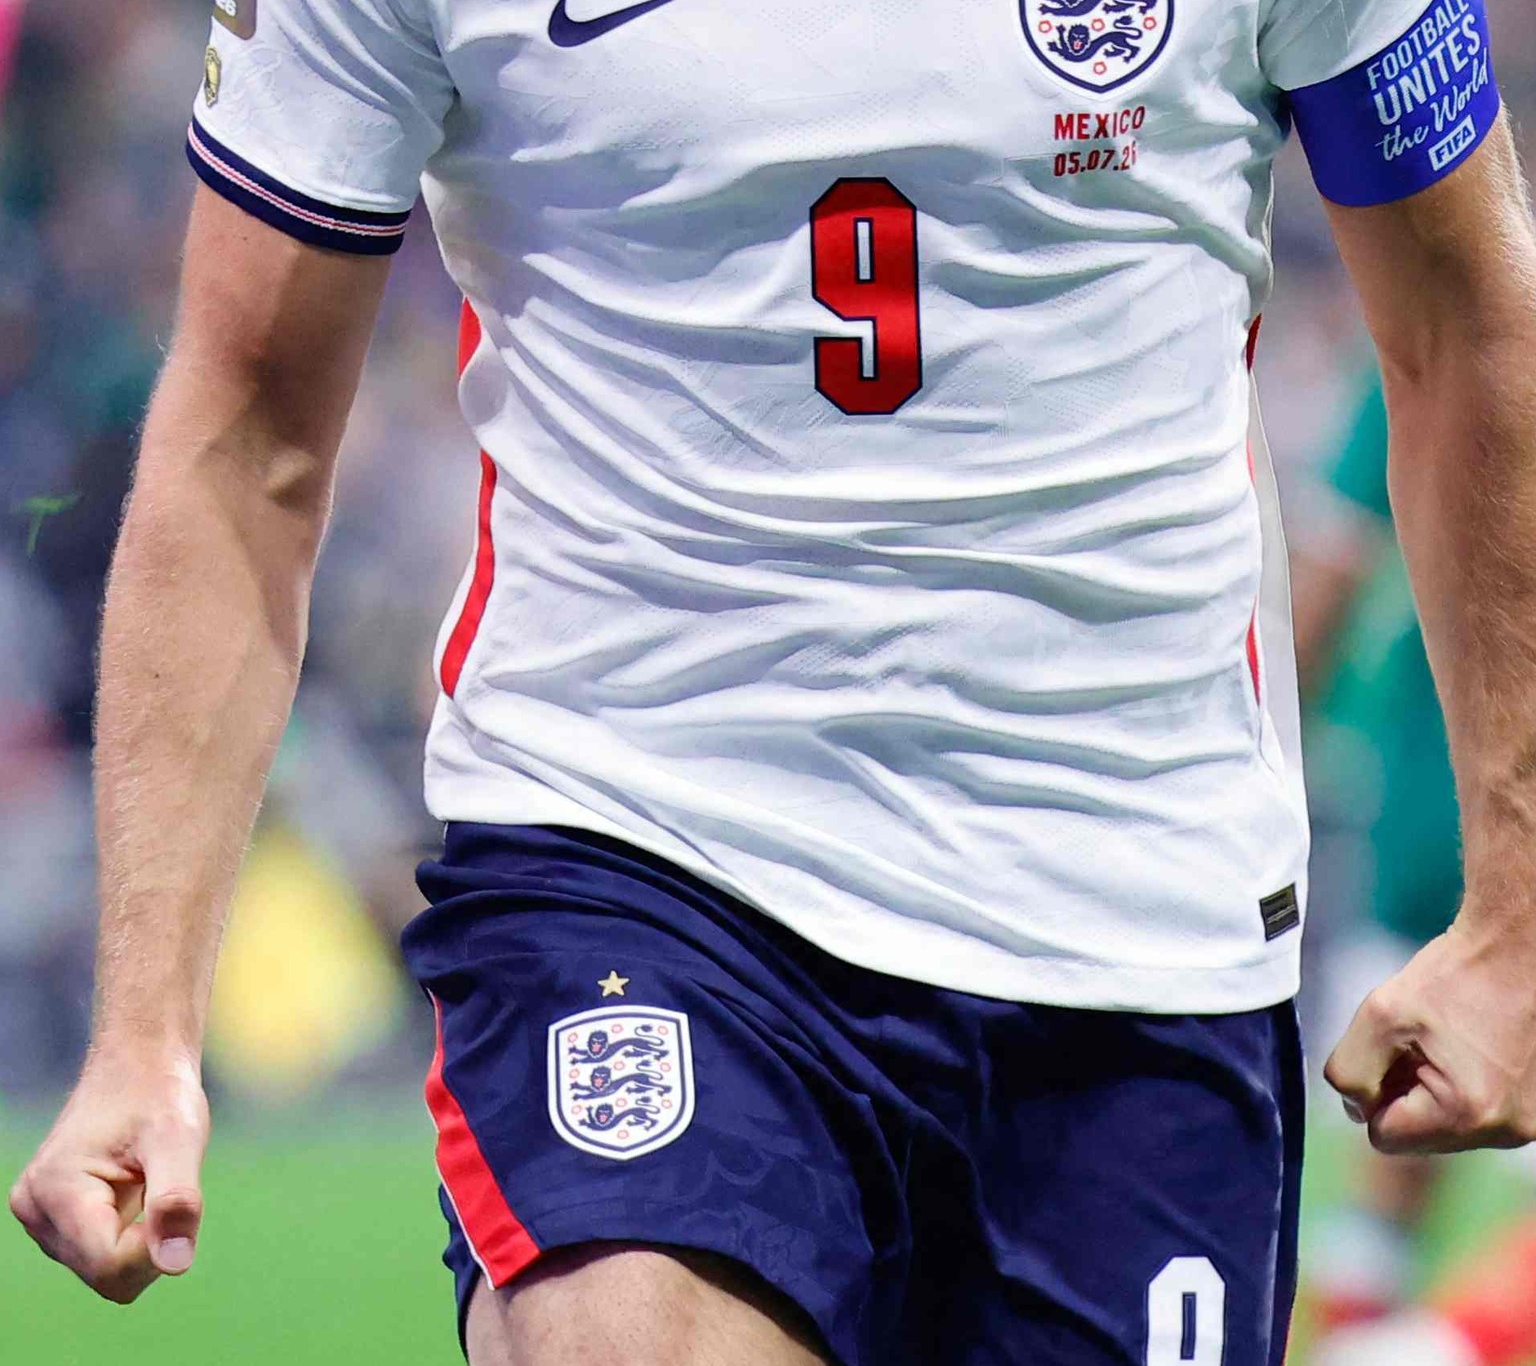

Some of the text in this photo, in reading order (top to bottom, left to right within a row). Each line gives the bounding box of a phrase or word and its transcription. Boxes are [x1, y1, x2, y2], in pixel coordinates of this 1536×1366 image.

[1054, 105, 1145, 140] MEXICO
[1373, 14, 1481, 125] UNITES
[1375, 47, 1488, 161] the World
[1433, 122, 1473, 165] FIFA
[810, 177, 923, 415] 9
